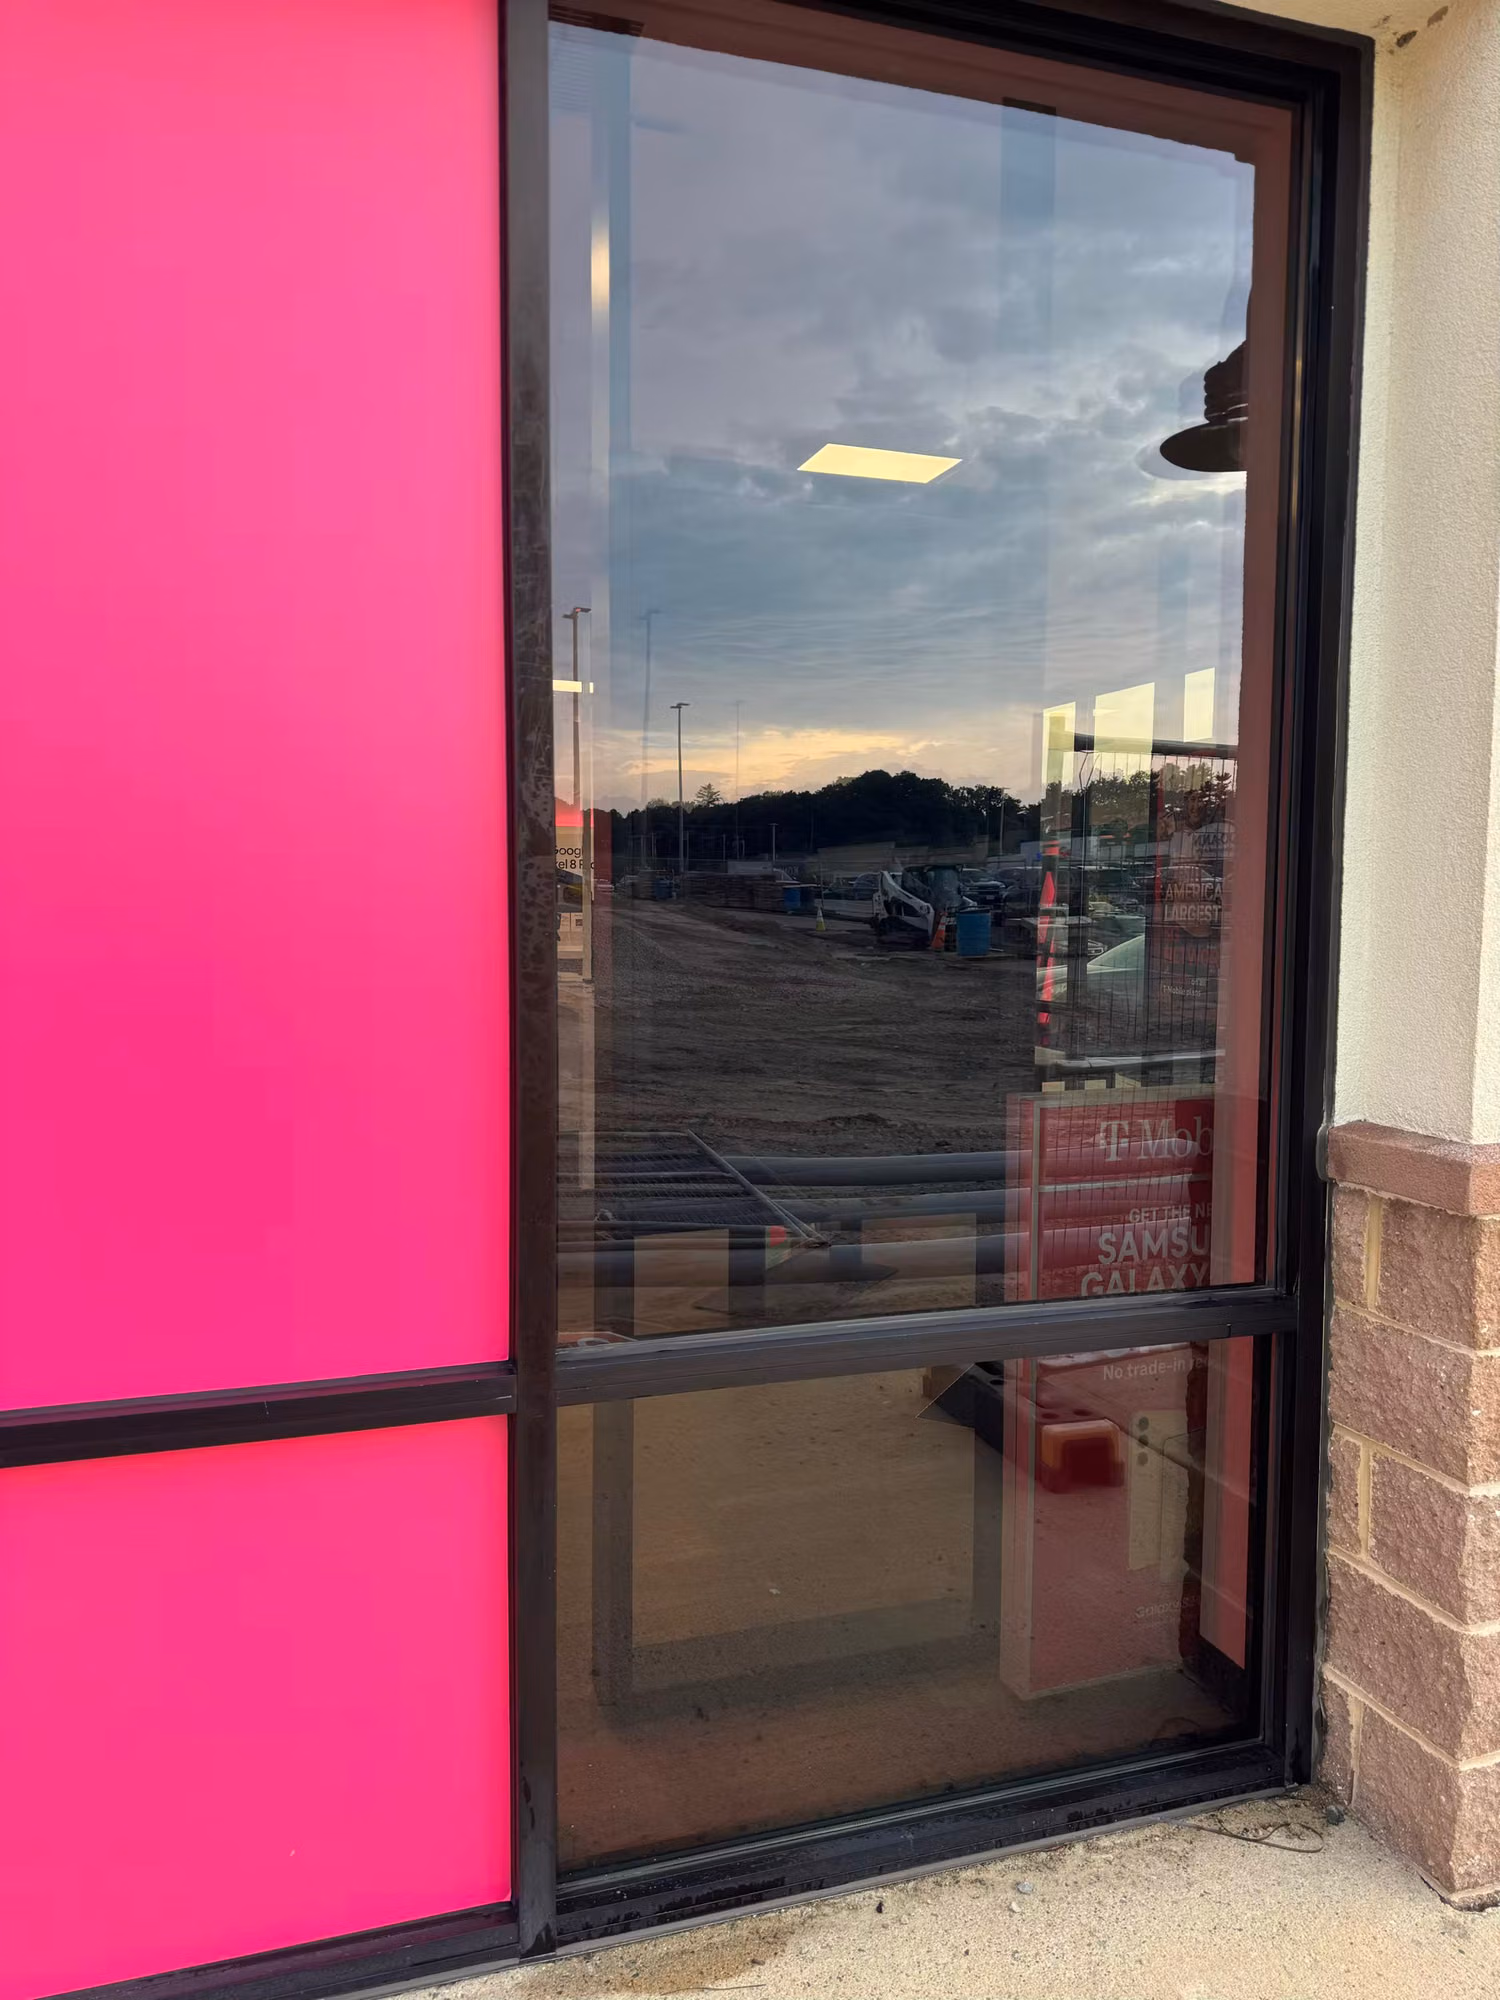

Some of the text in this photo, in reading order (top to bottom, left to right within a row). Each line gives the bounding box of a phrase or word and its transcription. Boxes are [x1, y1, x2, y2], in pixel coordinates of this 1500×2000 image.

[570, 859, 577, 869] 8
[1163, 904, 1221, 922] LARGEST
[1098, 1225, 1209, 1265] SAMSU
[1103, 1364, 1124, 1381] No
[1127, 1356, 1186, 1377] trade-in
